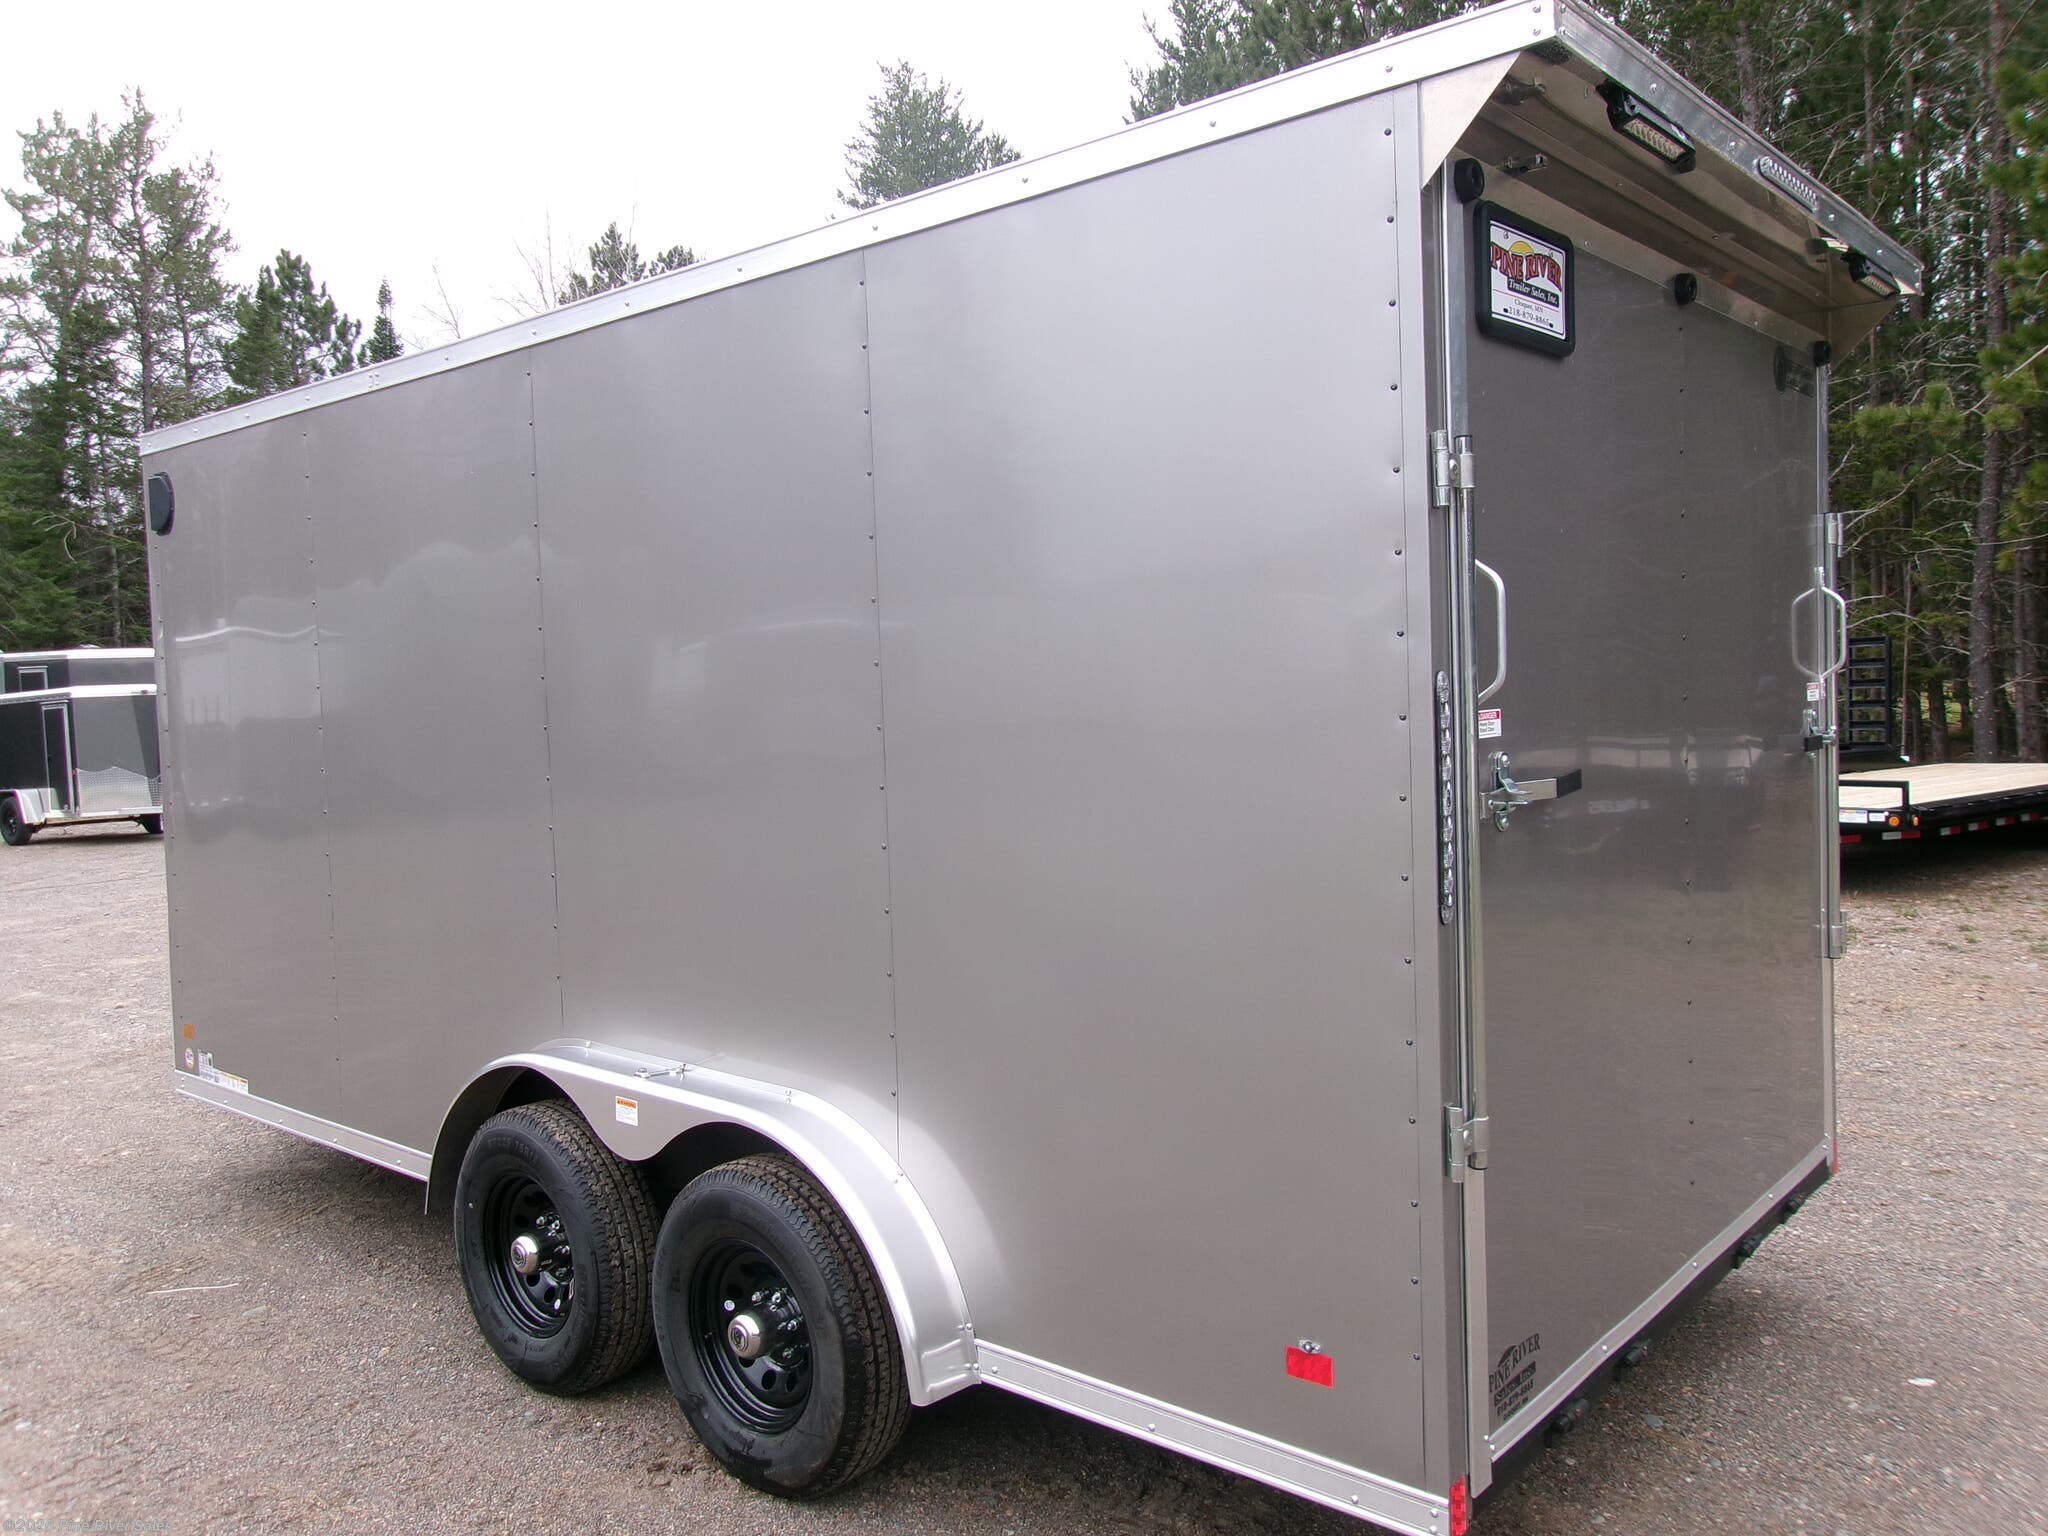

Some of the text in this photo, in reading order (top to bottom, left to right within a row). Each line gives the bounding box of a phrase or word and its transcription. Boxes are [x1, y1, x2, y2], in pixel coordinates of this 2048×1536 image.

[1491, 241, 1562, 292] PINE RIVER
[1509, 278, 1530, 293] Trailer
[1489, 1360, 1511, 1393] PINE
[1512, 1333, 1541, 1368] RIVER
